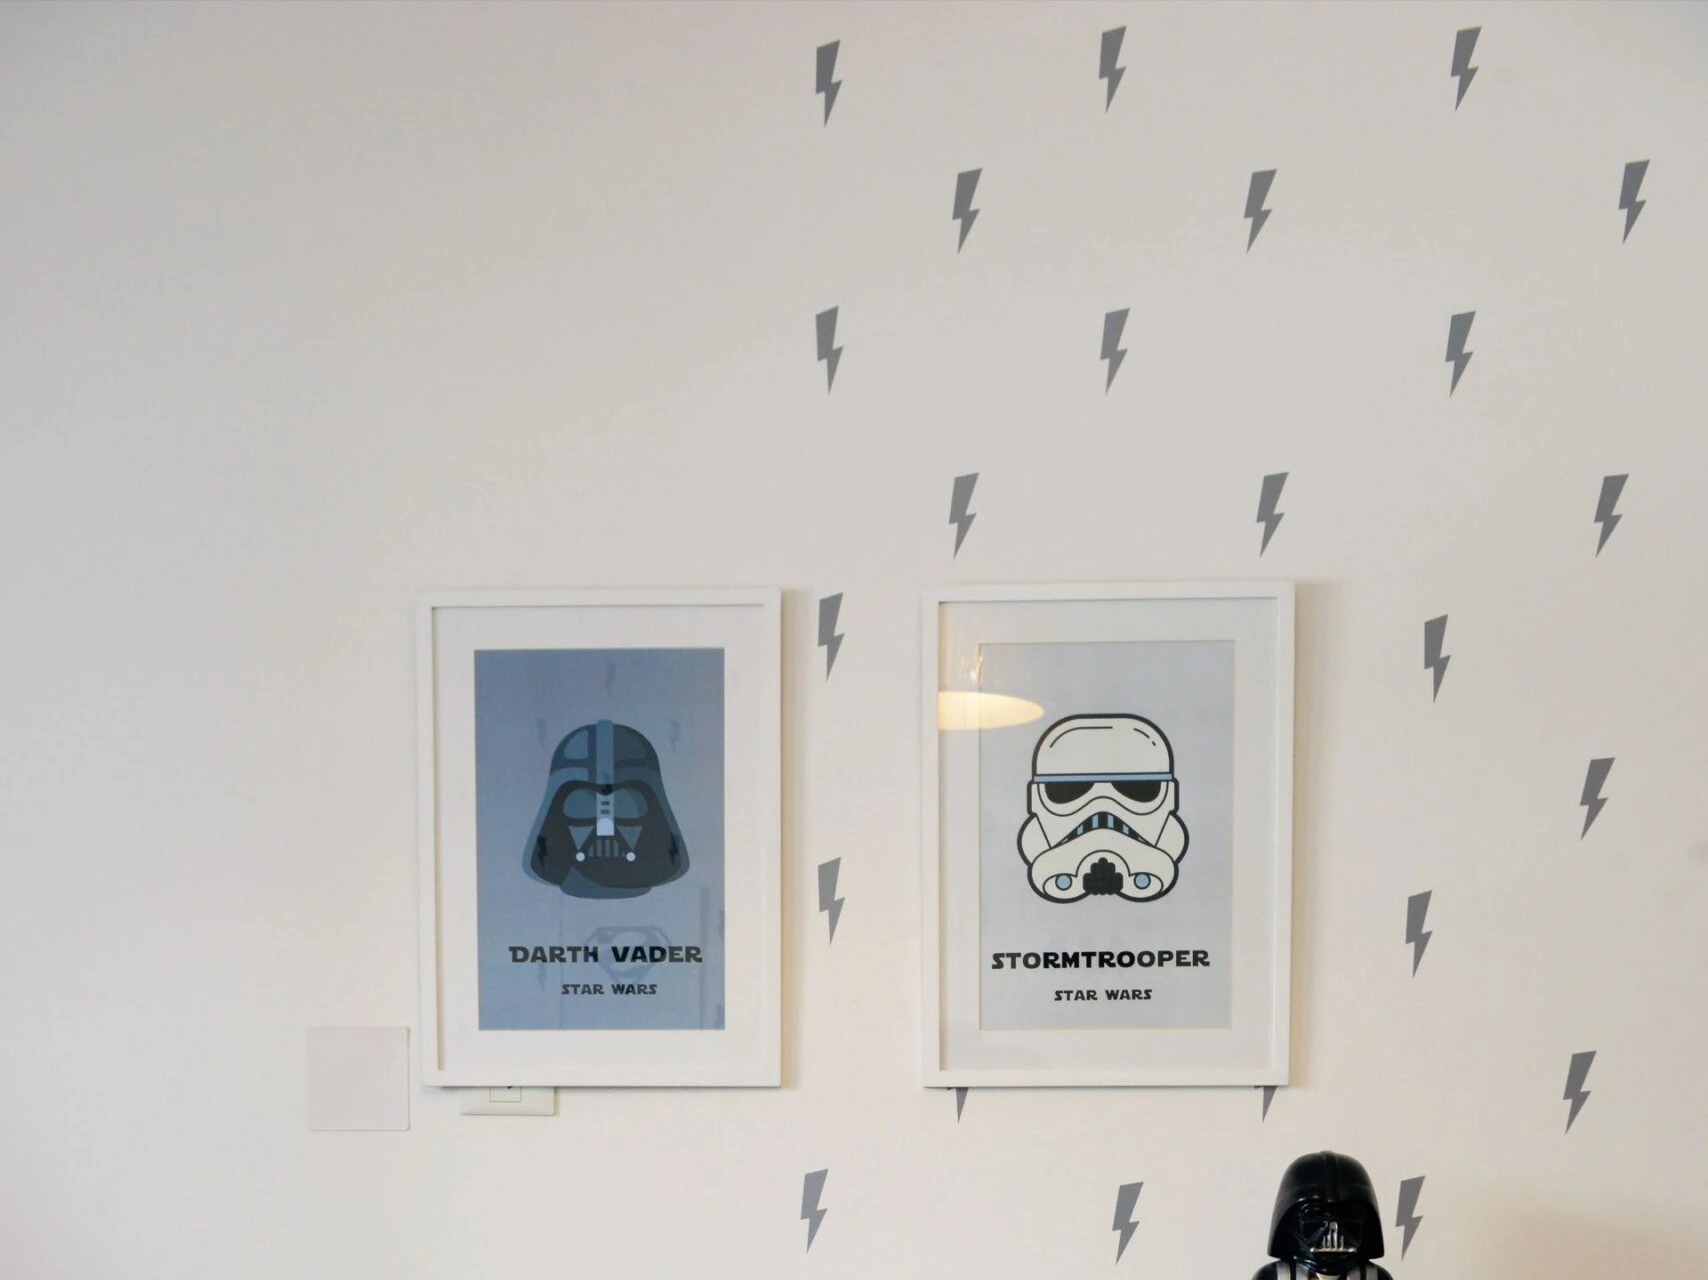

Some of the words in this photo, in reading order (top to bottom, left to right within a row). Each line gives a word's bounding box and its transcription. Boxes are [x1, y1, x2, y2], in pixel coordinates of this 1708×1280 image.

[508, 946, 599, 963] DARTH
[611, 946, 703, 963] VADER
[991, 950, 1211, 969] STORMTROOPER
[561, 983, 605, 995] STAR
[611, 983, 658, 995] WARS
[1054, 989, 1098, 1001] STAR
[1105, 988, 1153, 1001] WARS
